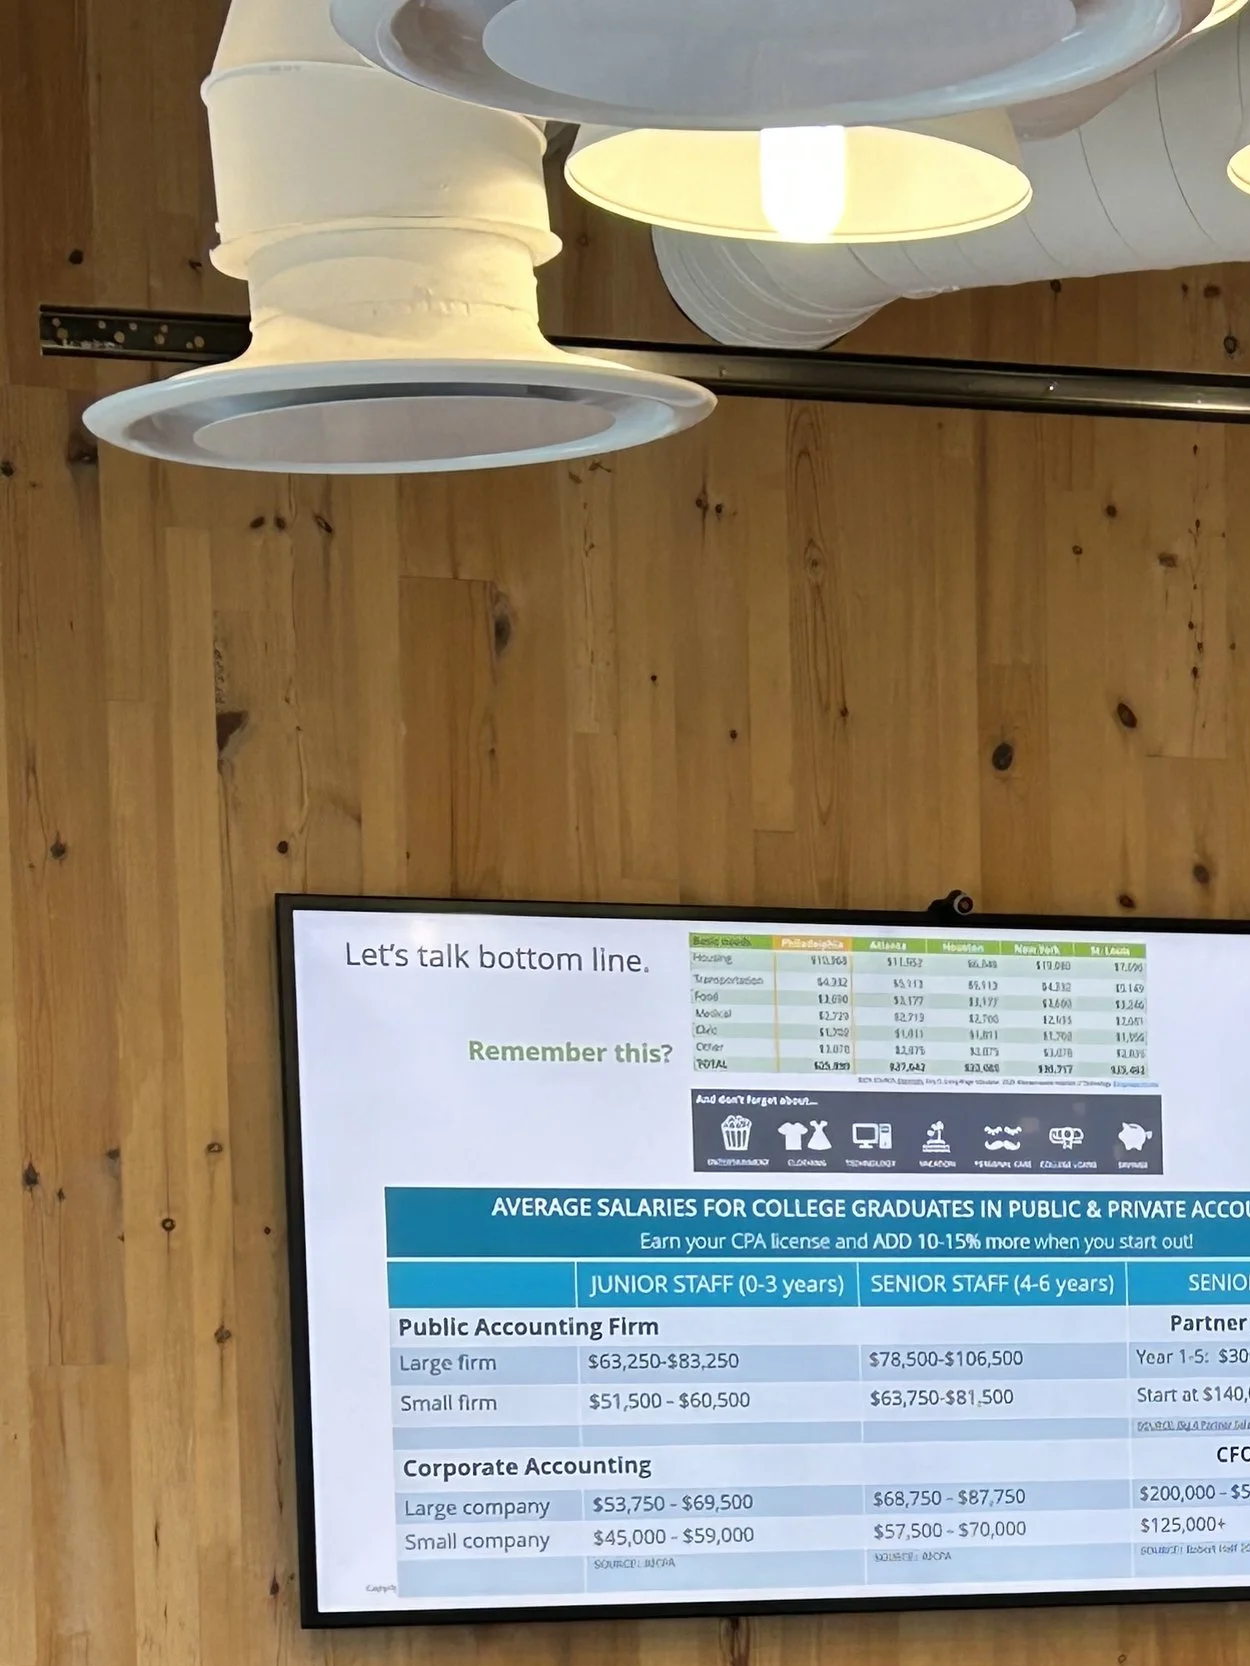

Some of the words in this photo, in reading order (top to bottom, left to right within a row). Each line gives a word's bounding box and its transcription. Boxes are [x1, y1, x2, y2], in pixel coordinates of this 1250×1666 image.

[417, 944, 470, 968] talk
[480, 944, 582, 971] bottom
[592, 947, 650, 973] line.
[694, 992, 718, 1002] Food
[469, 1040, 608, 1062] Remember
[614, 1042, 673, 1064] this?
[696, 1059, 728, 1070] TOTAL
[696, 1094, 716, 1104] And
[746, 1095, 778, 1107] forget
[492, 1199, 591, 1219] AVERAGE
[598, 1199, 698, 1219] SALARIES
[704, 1199, 746, 1219] FOR
[752, 1199, 846, 1219] COLLEGE
[852, 1199, 974, 1219] GRADUATES
[981, 1199, 1002, 1219] IN
[1009, 1199, 1080, 1219] PUBLIC
[1086, 1199, 1102, 1219] &
[1108, 1199, 1186, 1219] PRIVATE
[640, 1233, 680, 1249] Earn
[686, 1237, 726, 1255] your
[732, 1233, 766, 1249] CPA
[772, 1232, 830, 1250] license
[834, 1232, 868, 1250] and
[872, 1234, 912, 1250] ADD
[918, 1234, 982, 1250] 10-15%
[986, 1237, 1030, 1250] more
[1034, 1233, 1080, 1250] when
[1084, 1237, 1116, 1255] you
[1120, 1234, 1158, 1250] start
[1162, 1233, 1194, 1250] out!
[590, 1276, 668, 1296] JUNIOR
[673, 1276, 733, 1294] STAFF
[739, 1276, 777, 1296] (0-3
[783, 1276, 844, 1298] years)
[872, 1276, 946, 1294] SENIOR
[953, 1275, 1009, 1294] STAFF
[1014, 1275, 1050, 1296] (4-6
[1056, 1274, 1114, 1298] years)
[400, 1318, 468, 1336] Public
[474, 1317, 602, 1340] Accounting
[610, 1318, 658, 1336] Firm
[1171, 1314, 1247, 1332] Partner
[400, 1356, 452, 1376] Large
[458, 1354, 496, 1370] firm
[588, 1353, 739, 1372] $63,250-$83,250
[869, 1350, 1024, 1369] $78,500-$106,500
[1136, 1349, 1172, 1364] Year
[1180, 1349, 1208, 1364] 1-5:
[400, 1394, 452, 1412] Small
[458, 1395, 497, 1412] firm
[590, 1392, 662, 1412] $51,500
[679, 1392, 750, 1410] $60,500
[870, 1390, 1014, 1408] $63,750-$81,500
[1138, 1386, 1178, 1402] Start
[1182, 1388, 1198, 1402] at
[404, 1458, 518, 1481] Corporate
[524, 1456, 652, 1478] Accounting
[873, 1490, 942, 1508] $68,750
[958, 1488, 1026, 1506] $87,750
[1140, 1484, 1215, 1502] $200,000
[405, 1500, 457, 1520] Large
[463, 1501, 550, 1520] company
[593, 1495, 665, 1514] $53,750
[682, 1494, 753, 1512] $69,500
[874, 1522, 942, 1540] $57,500
[958, 1521, 1026, 1539] $70,000
[1140, 1516, 1226, 1534] $125,000+
[405, 1533, 457, 1550] Small
[462, 1534, 550, 1553] company
[594, 1529, 666, 1548] $45,000
[683, 1527, 754, 1546] $59,000
